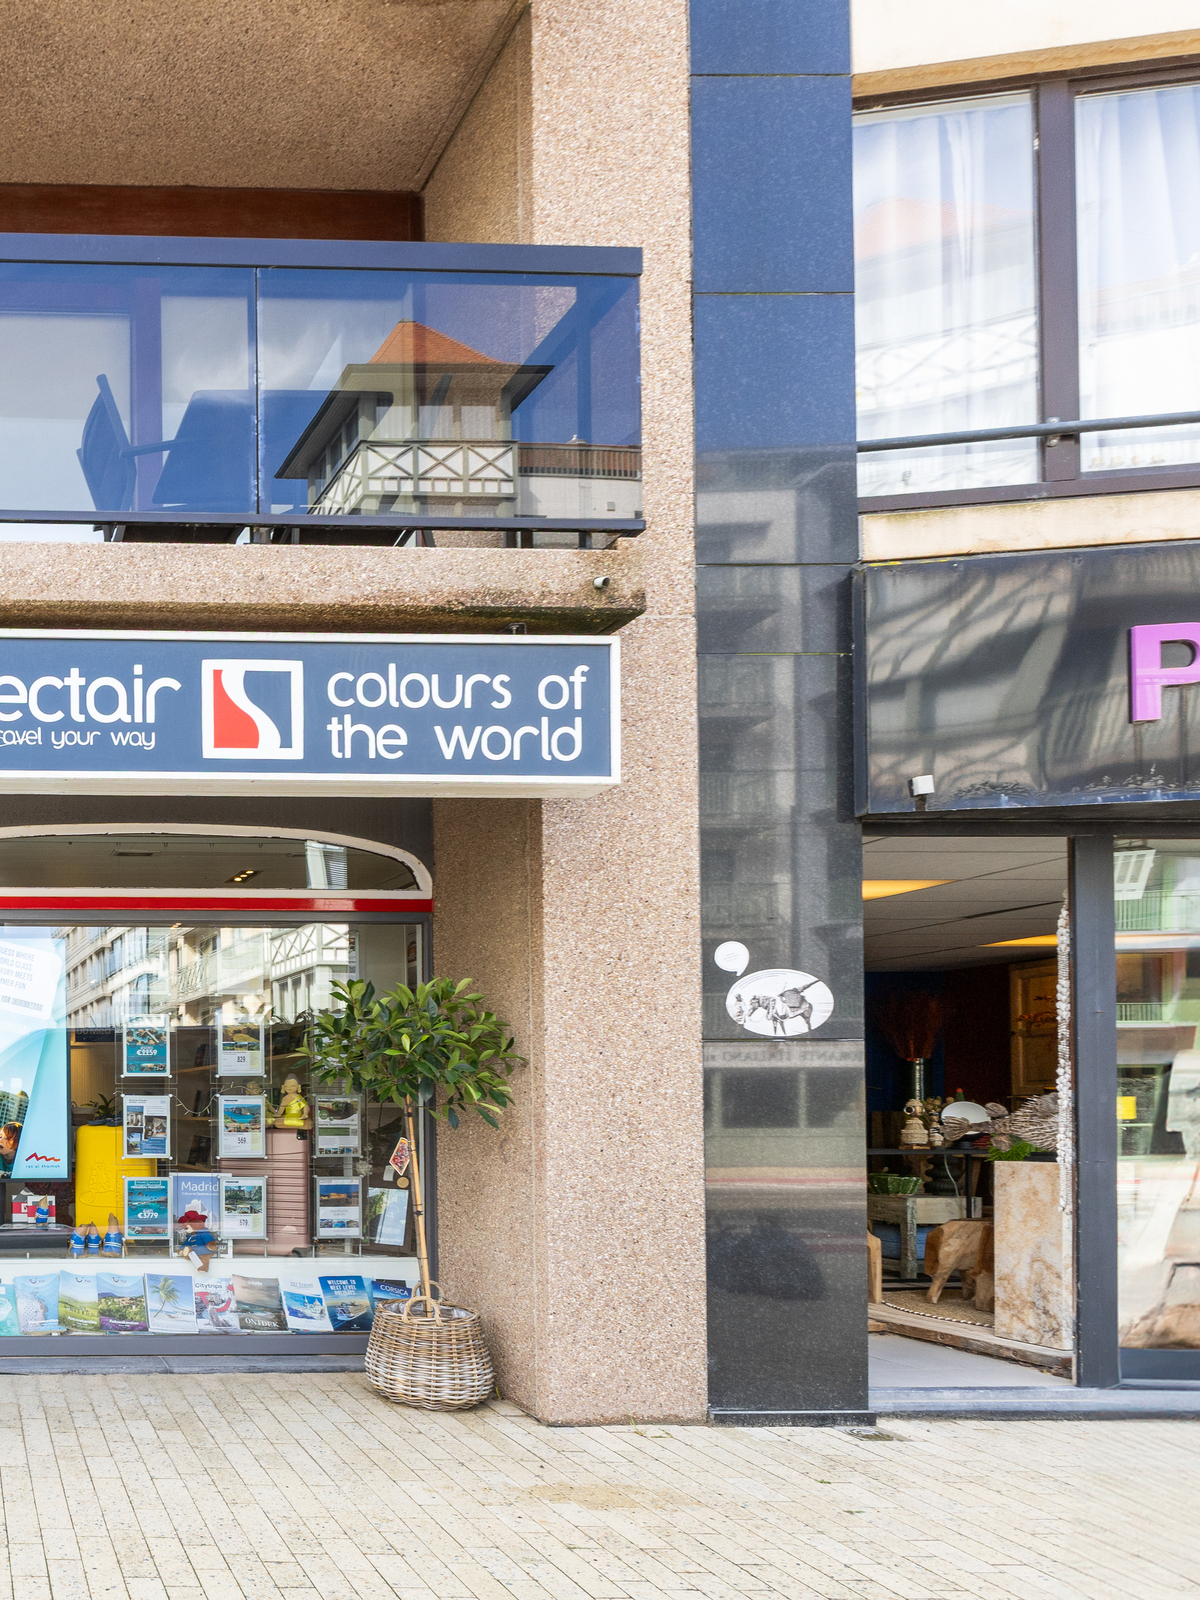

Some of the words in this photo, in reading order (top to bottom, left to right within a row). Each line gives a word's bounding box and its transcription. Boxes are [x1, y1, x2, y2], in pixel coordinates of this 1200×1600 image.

[1128, 621, 1200, 723] P
[328, 663, 511, 709] colours
[538, 665, 589, 709] of
[51, 730, 101, 749] your
[110, 732, 155, 750] way
[327, 714, 407, 759] the
[434, 717, 582, 761] world
[15, 950, 35, 962] WHERE
[15, 960, 32, 971] CLASS
[14, 970, 33, 982] MEETS
[181, 1181, 219, 1192] Madrid
[380, 1284, 409, 1297] CORSICA
[245, 1317, 280, 1328] ONTDEK
